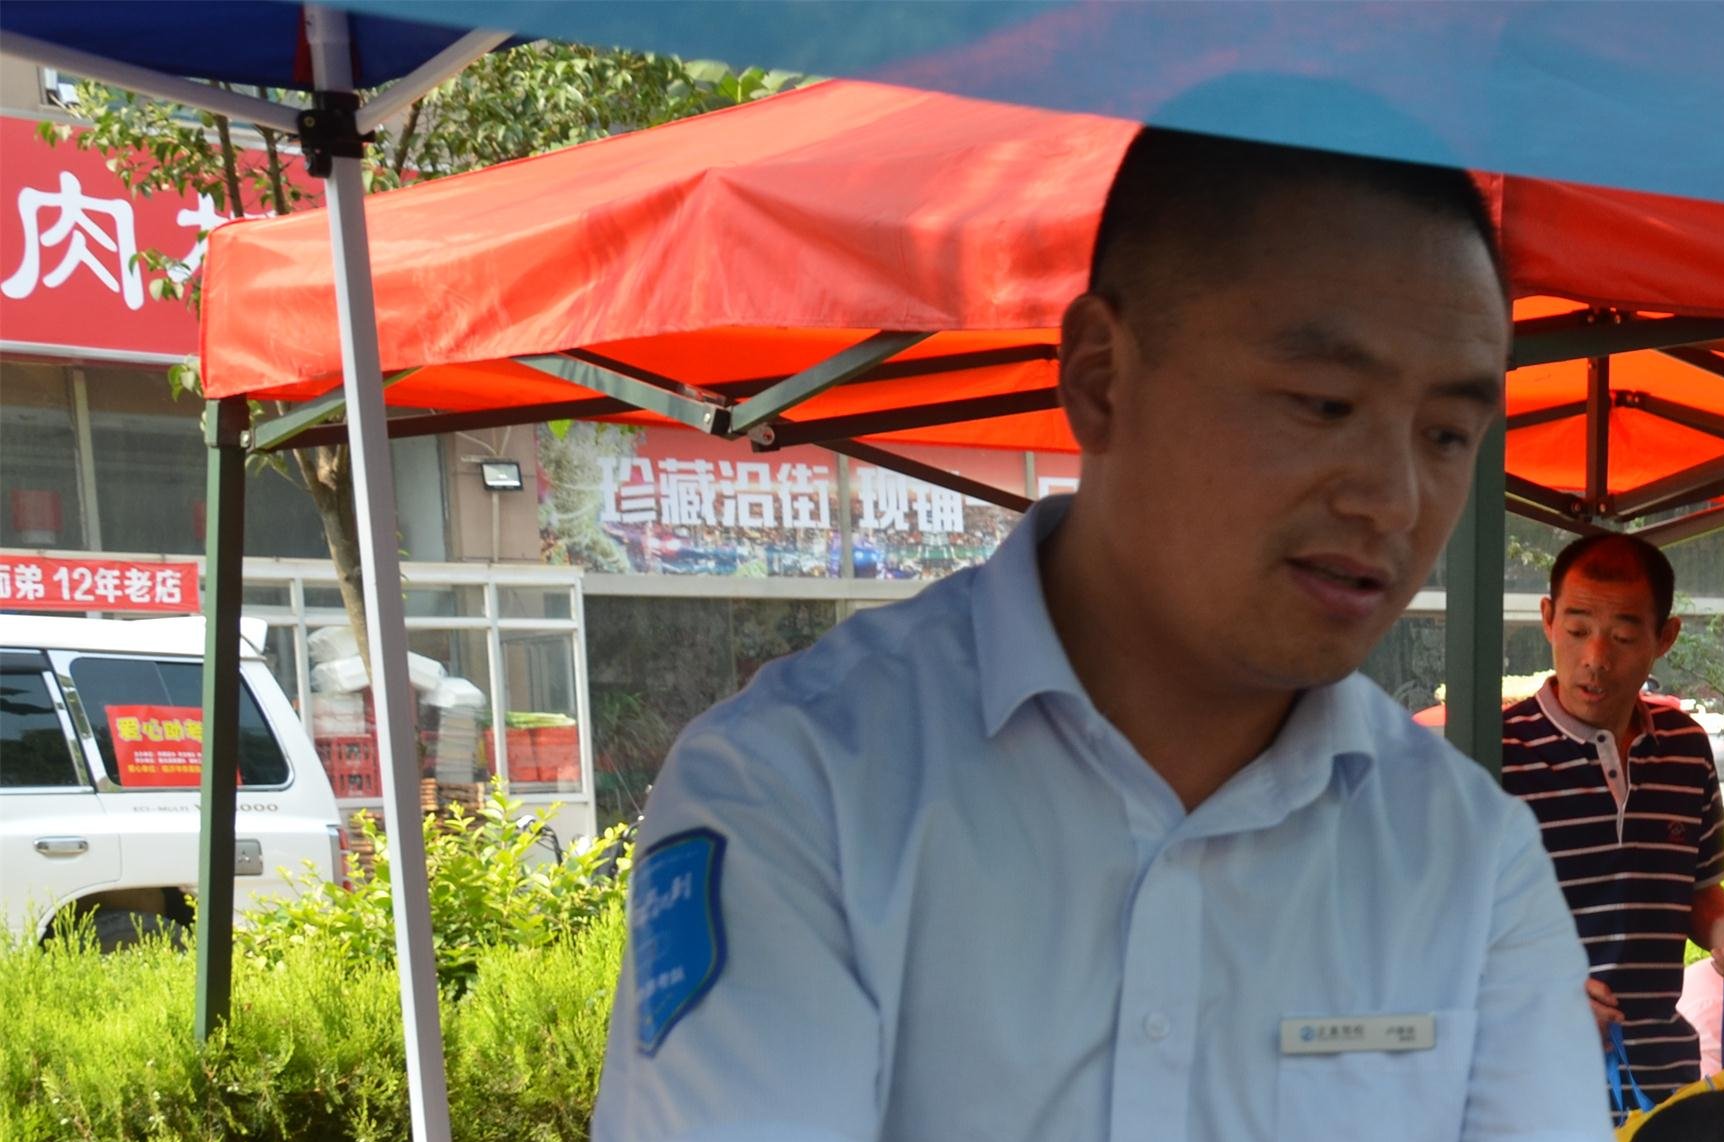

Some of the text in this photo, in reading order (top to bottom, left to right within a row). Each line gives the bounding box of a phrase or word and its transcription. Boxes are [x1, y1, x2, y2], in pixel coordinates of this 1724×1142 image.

[600, 457, 831, 529] 珍藏沿街
[53, 566, 182, 604] 12年老店
